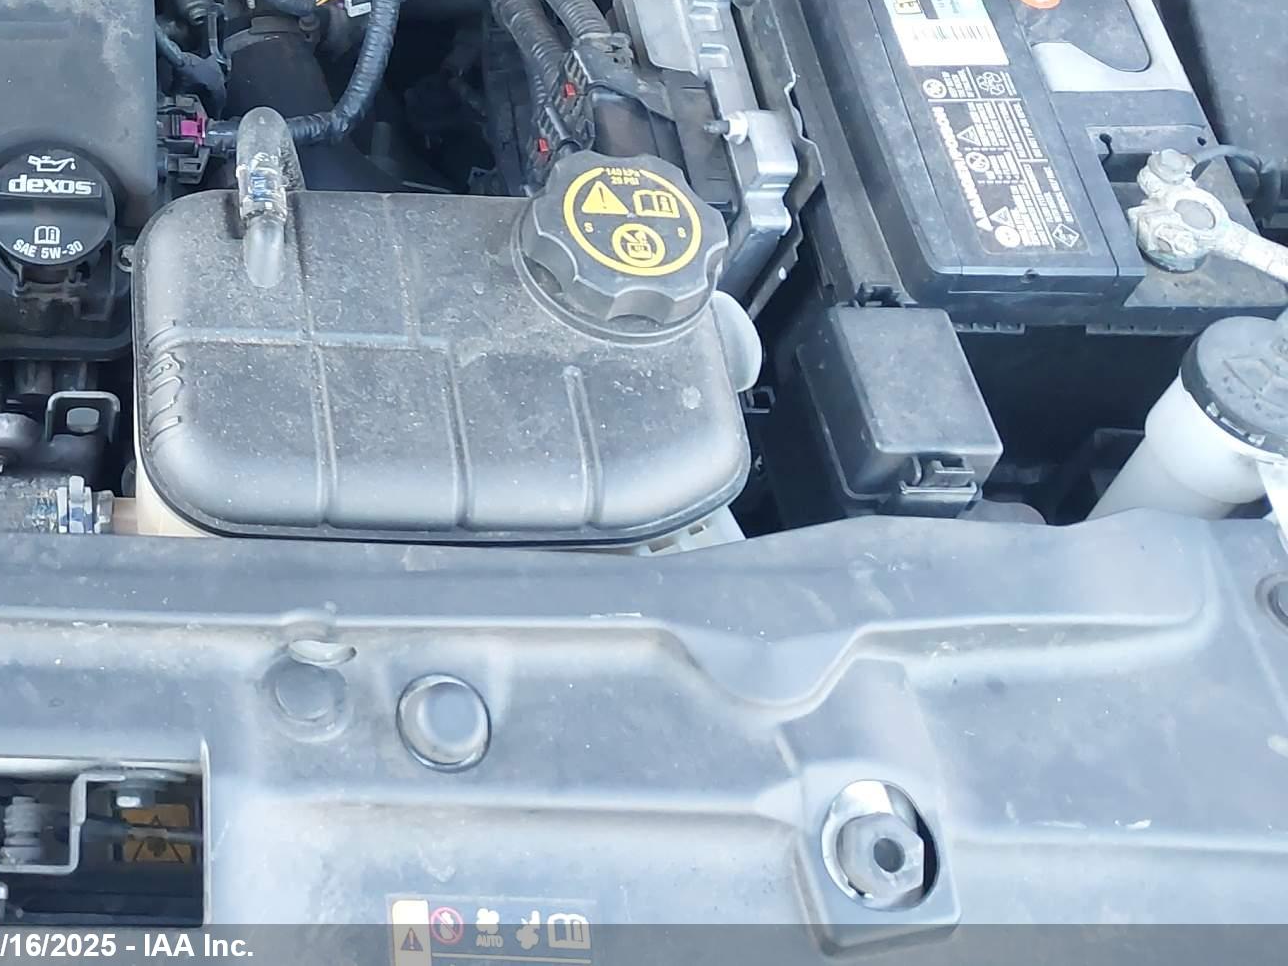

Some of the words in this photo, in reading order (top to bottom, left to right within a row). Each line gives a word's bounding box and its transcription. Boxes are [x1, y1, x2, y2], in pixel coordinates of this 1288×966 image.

[8, 174, 93, 195] dexos
[13, 239, 37, 258] SAE
[40, 240, 83, 259] 5W-30
[475, 935, 504, 948] AUTO
